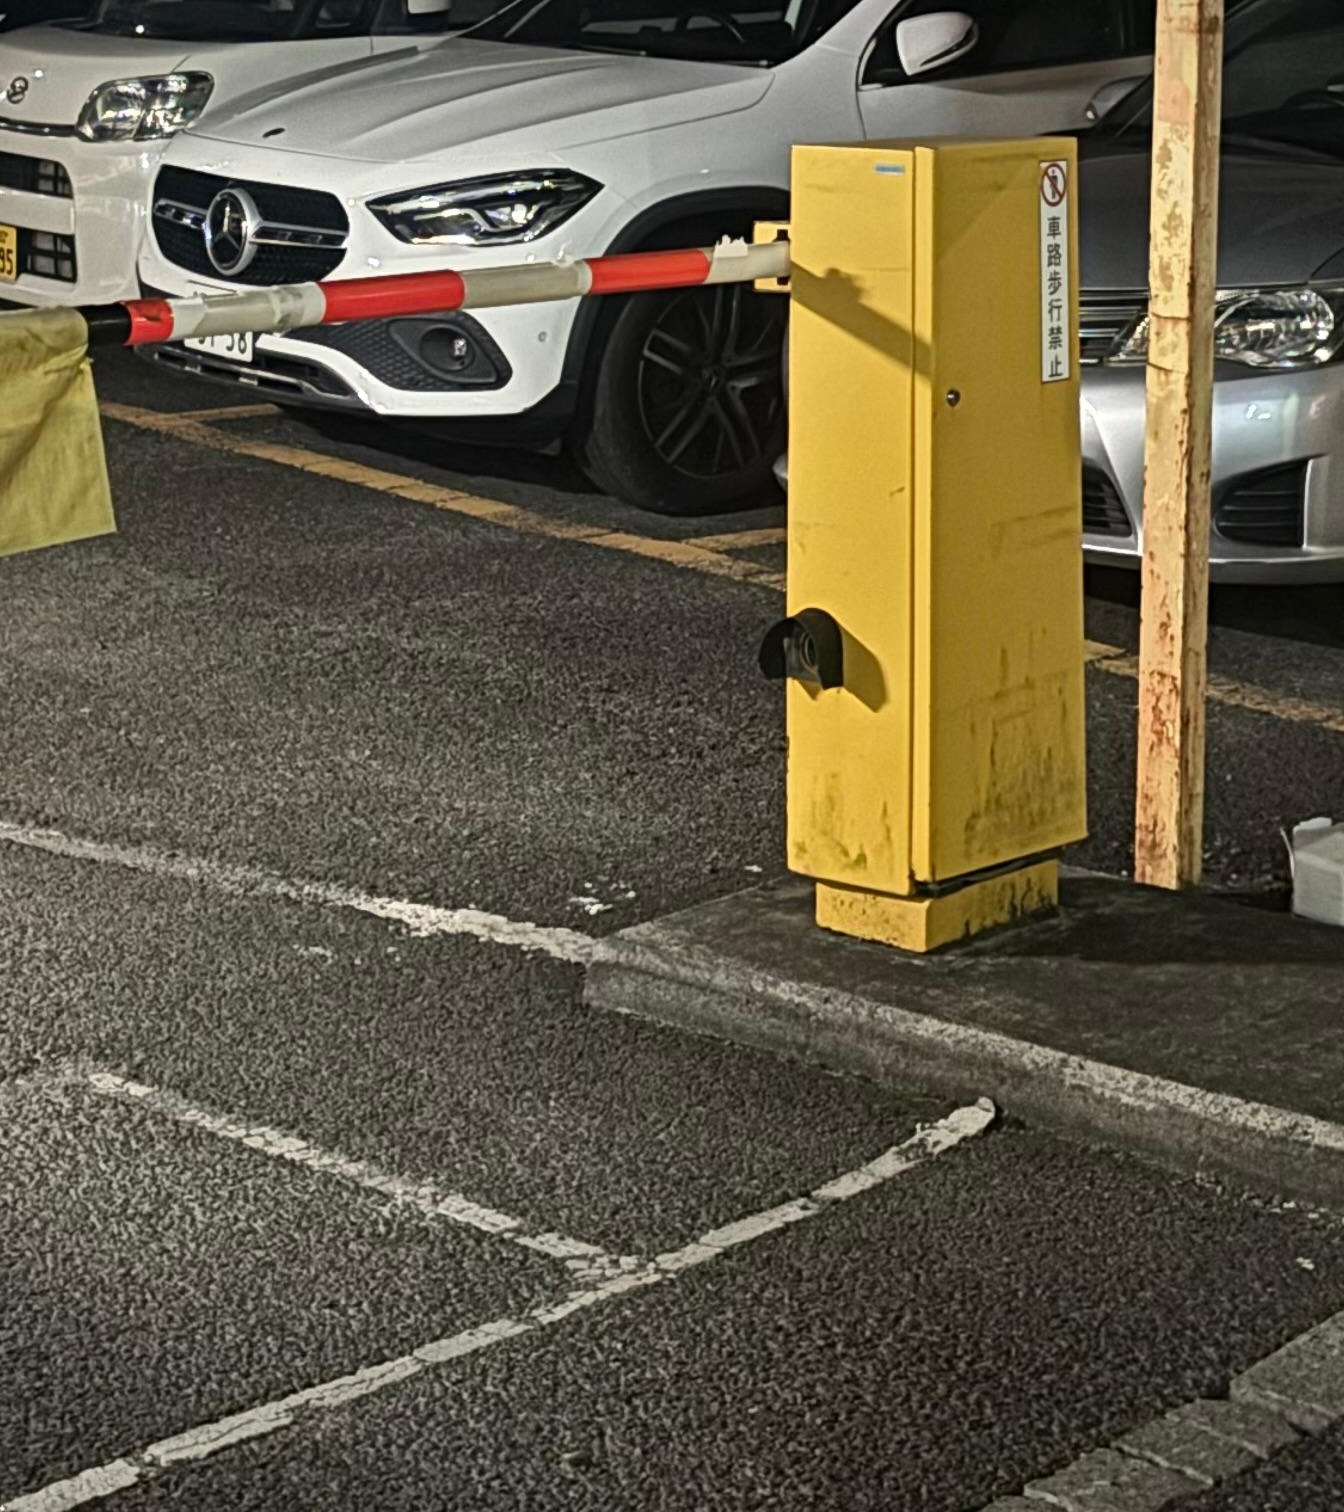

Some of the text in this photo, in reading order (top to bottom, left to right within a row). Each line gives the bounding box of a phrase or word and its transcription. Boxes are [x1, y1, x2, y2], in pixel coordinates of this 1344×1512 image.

[1047, 216, 1063, 378] 車路歩行禁止
